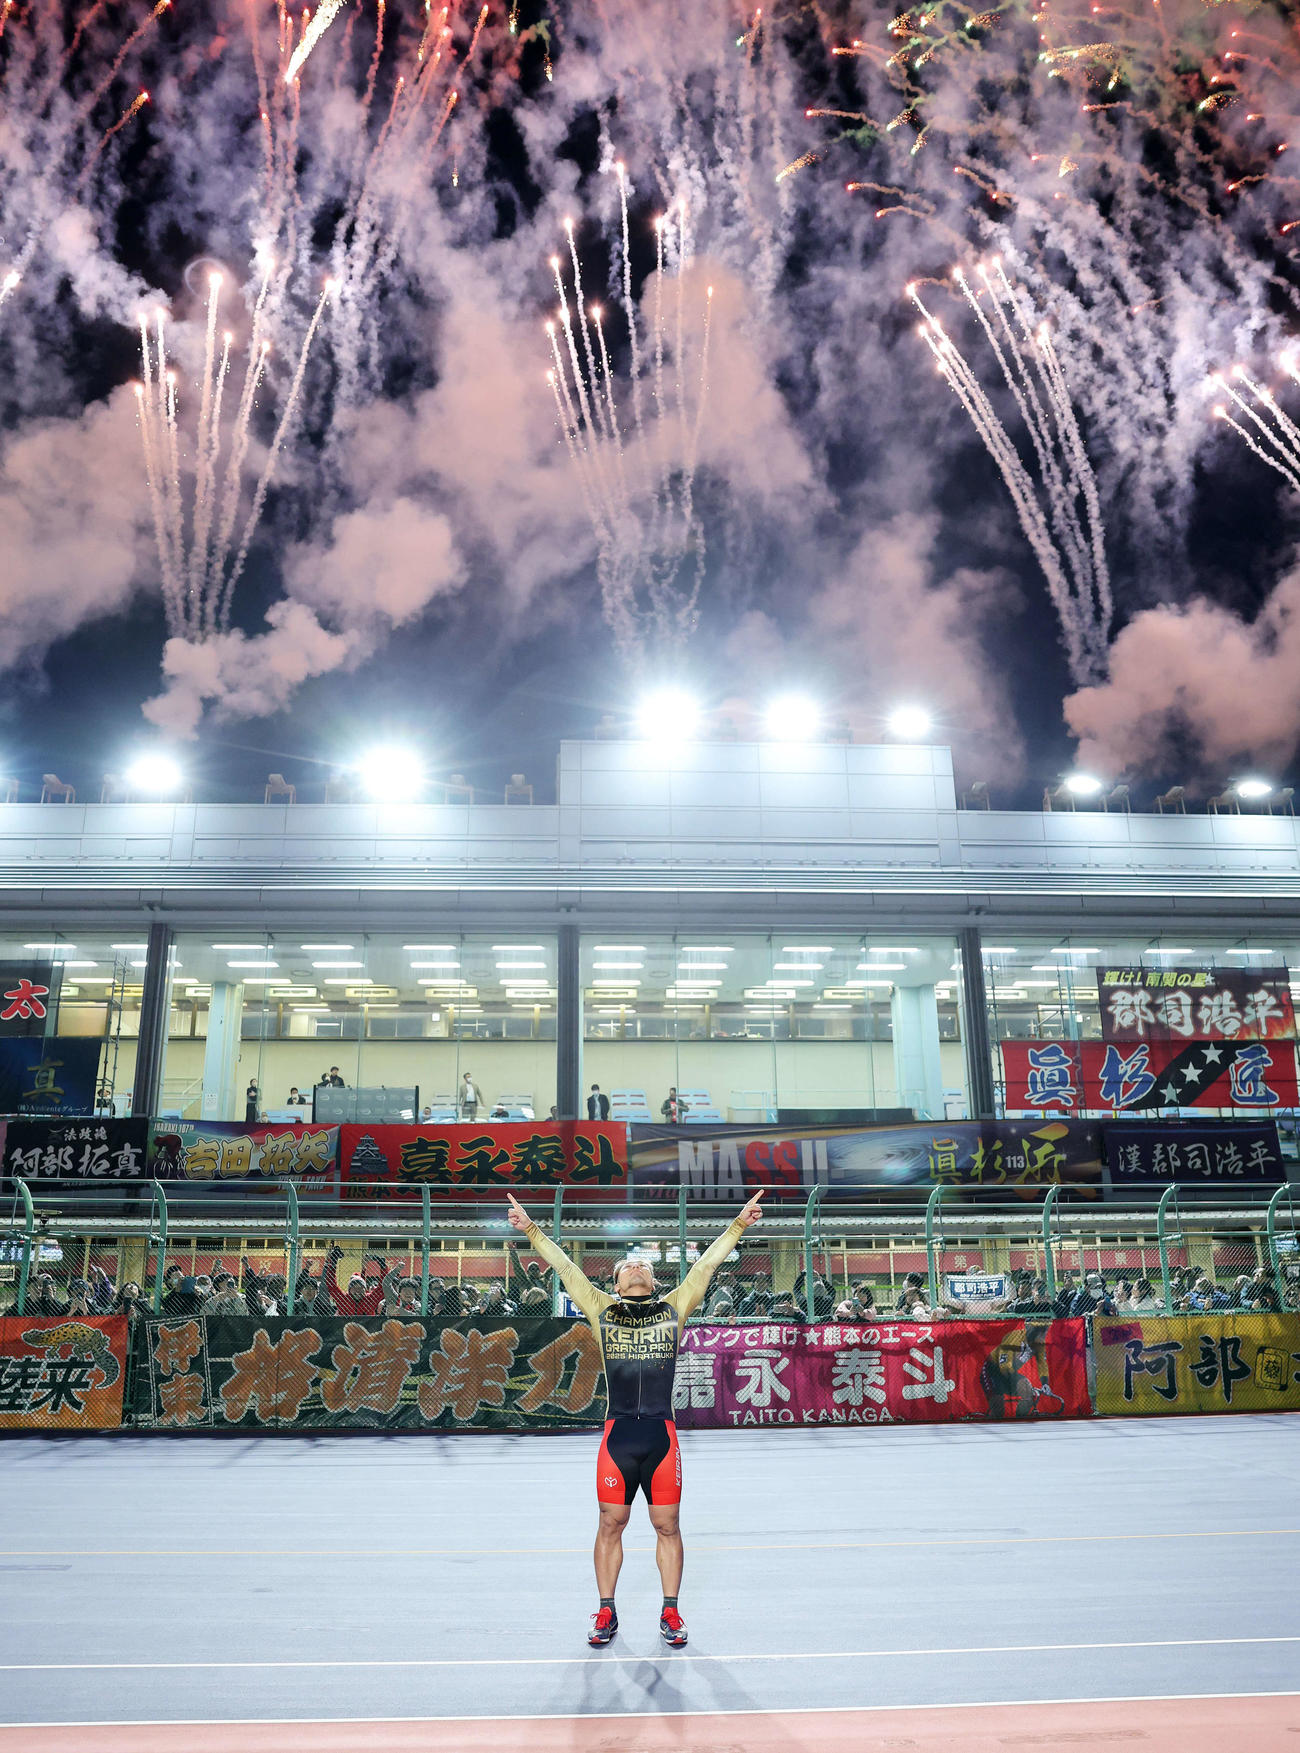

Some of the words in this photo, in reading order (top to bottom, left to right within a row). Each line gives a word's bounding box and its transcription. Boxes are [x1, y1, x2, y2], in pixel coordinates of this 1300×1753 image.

[1, 979, 49, 1019] 太
[1107, 990, 1284, 1037] 郡司浩平
[10, 1142, 143, 1178] 阿部拓真
[183, 1129, 332, 1180] 吉田拓矢
[395, 1135, 623, 1195] 嘉永泰斗
[1006, 1156, 1025, 1169] 113
[604, 1308, 672, 1327] CHAMPION
[605, 1326, 674, 1344] KEIRIN
[605, 1343, 647, 1353] GRAND
[649, 1342, 674, 1353] PRIX
[628, 1352, 674, 1360] HIRATSUKA
[674, 1346, 955, 1410] 嘉永泰斗
[729, 1408, 795, 1425] TAITO
[802, 1407, 894, 1423] KANAGA
